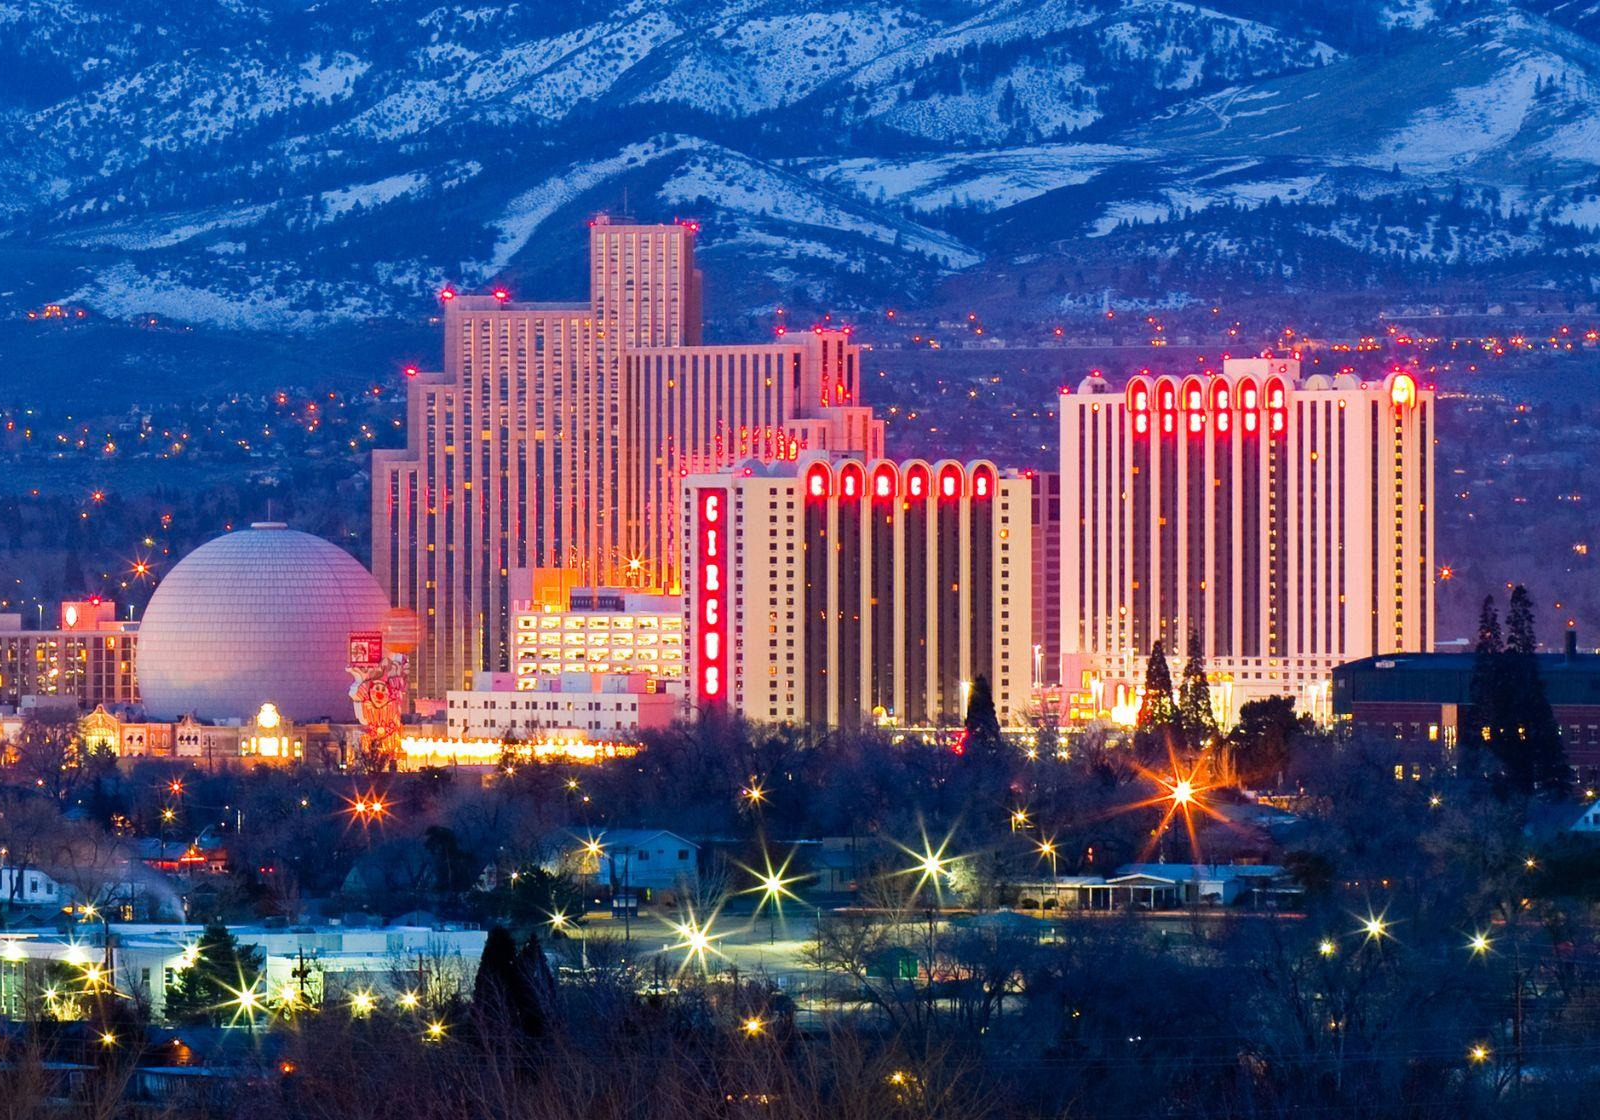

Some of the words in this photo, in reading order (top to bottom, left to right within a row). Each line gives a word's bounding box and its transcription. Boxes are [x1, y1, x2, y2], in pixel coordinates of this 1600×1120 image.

[1136, 391, 1283, 410] CIRCUS
[1136, 413, 1283, 433] CIRCUS
[811, 475, 986, 497] CIRCUS
[705, 495, 719, 695] CIRCUS
